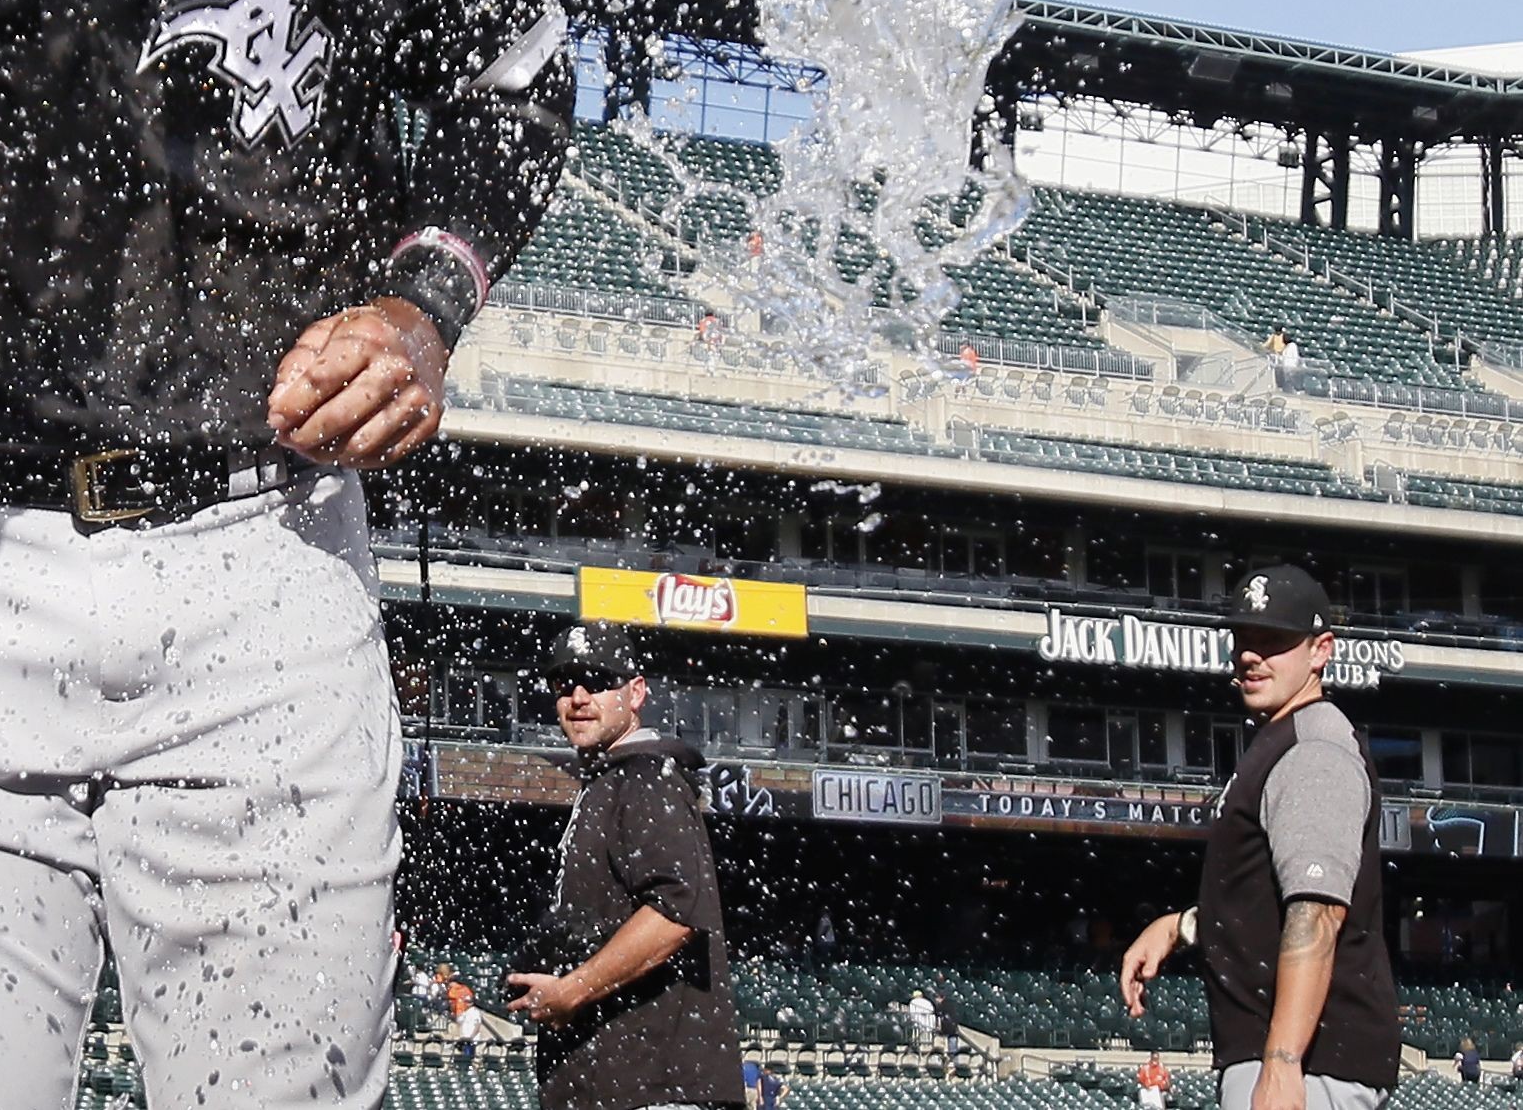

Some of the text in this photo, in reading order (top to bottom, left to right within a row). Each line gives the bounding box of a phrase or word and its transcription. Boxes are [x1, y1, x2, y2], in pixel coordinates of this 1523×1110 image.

[1040, 608, 1120, 664] JACK
[1329, 639, 1405, 670] PIONS
[1321, 664, 1365, 686] LUB
[820, 776, 935, 816] CHICAGO
[978, 793, 1107, 820] TODAY'S
